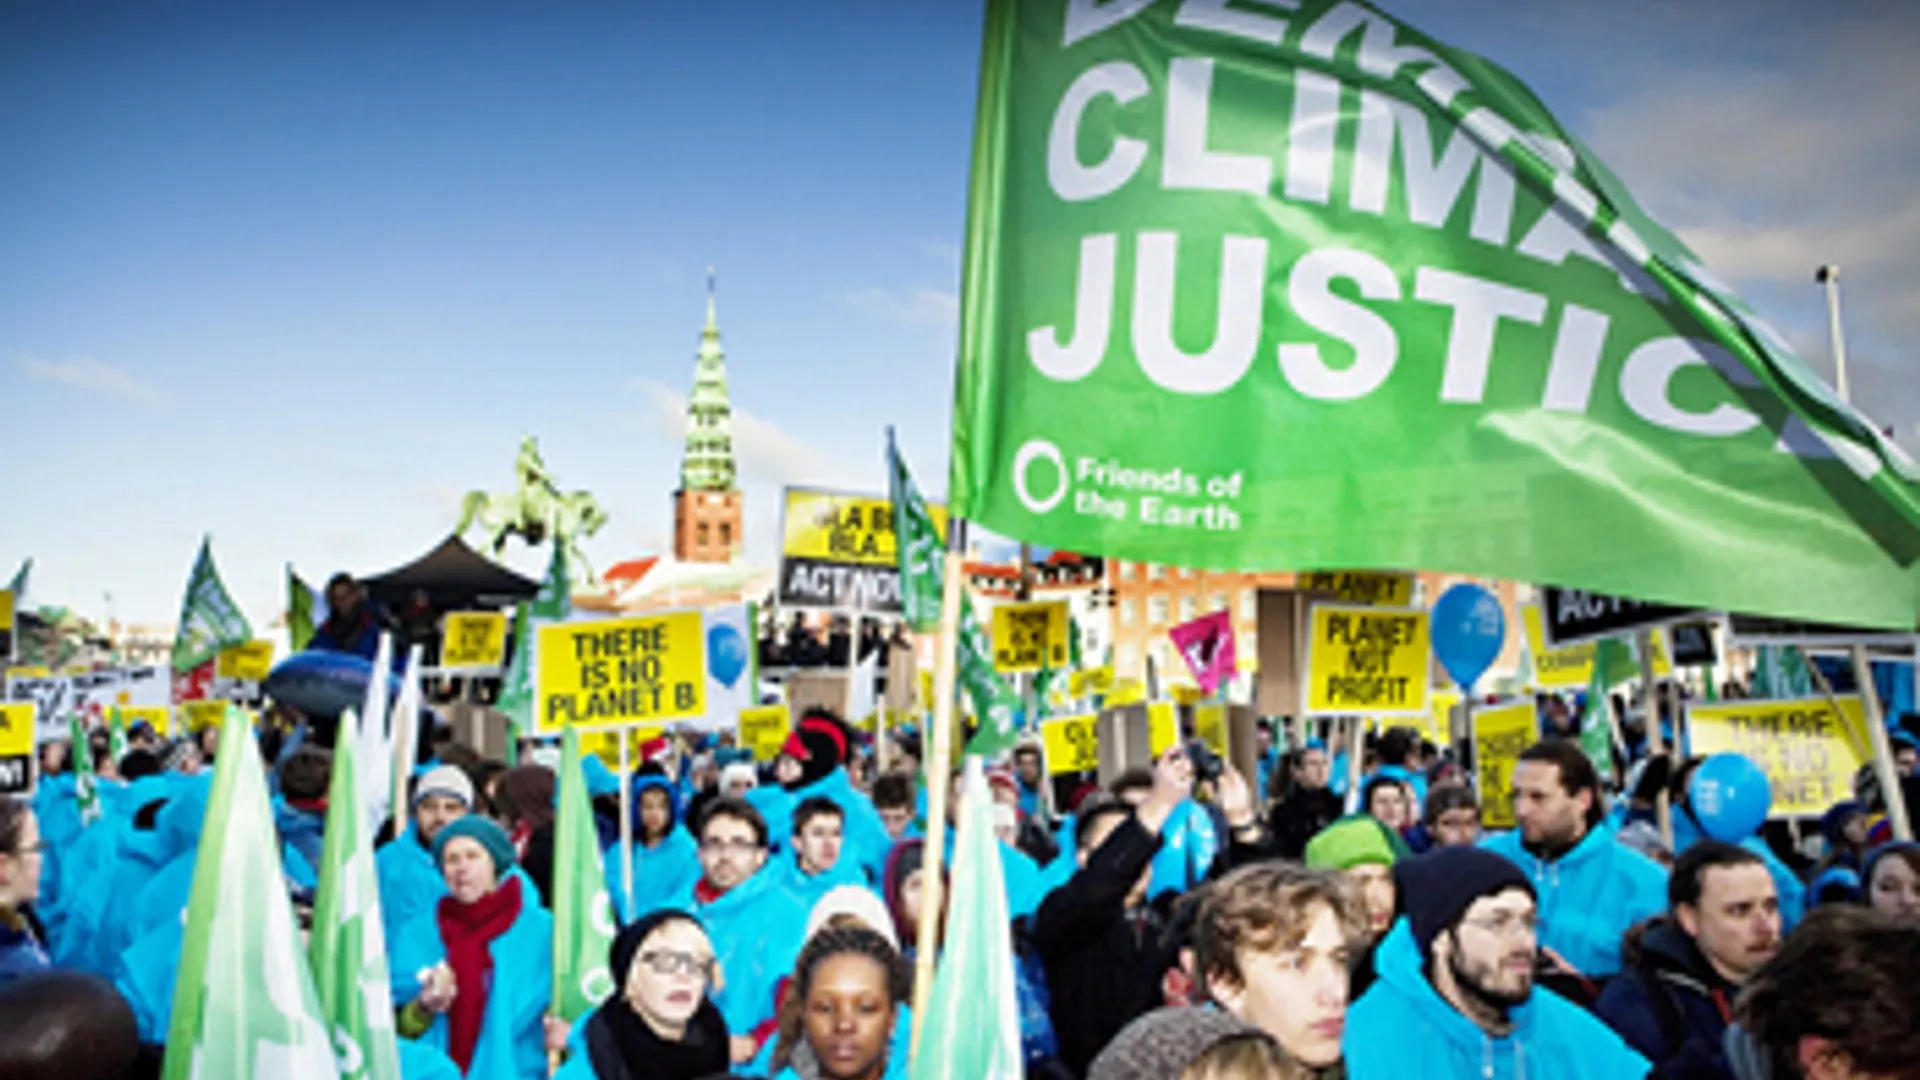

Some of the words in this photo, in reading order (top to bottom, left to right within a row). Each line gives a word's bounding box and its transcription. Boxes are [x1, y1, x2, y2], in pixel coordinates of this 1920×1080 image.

[1076, 457, 1200, 497] Friends
[1207, 470, 1244, 498] of
[1075, 491, 1126, 520] the
[1141, 497, 1242, 530] Earth
[790, 566, 846, 597] ACT
[571, 622, 669, 661] THERE
[1327, 613, 1417, 646] PLANET
[581, 659, 610, 689] IS
[618, 655, 662, 685] NO
[1349, 647, 1391, 674] NOT
[546, 682, 664, 723] PLANET
[1327, 675, 1410, 706] PROFIT
